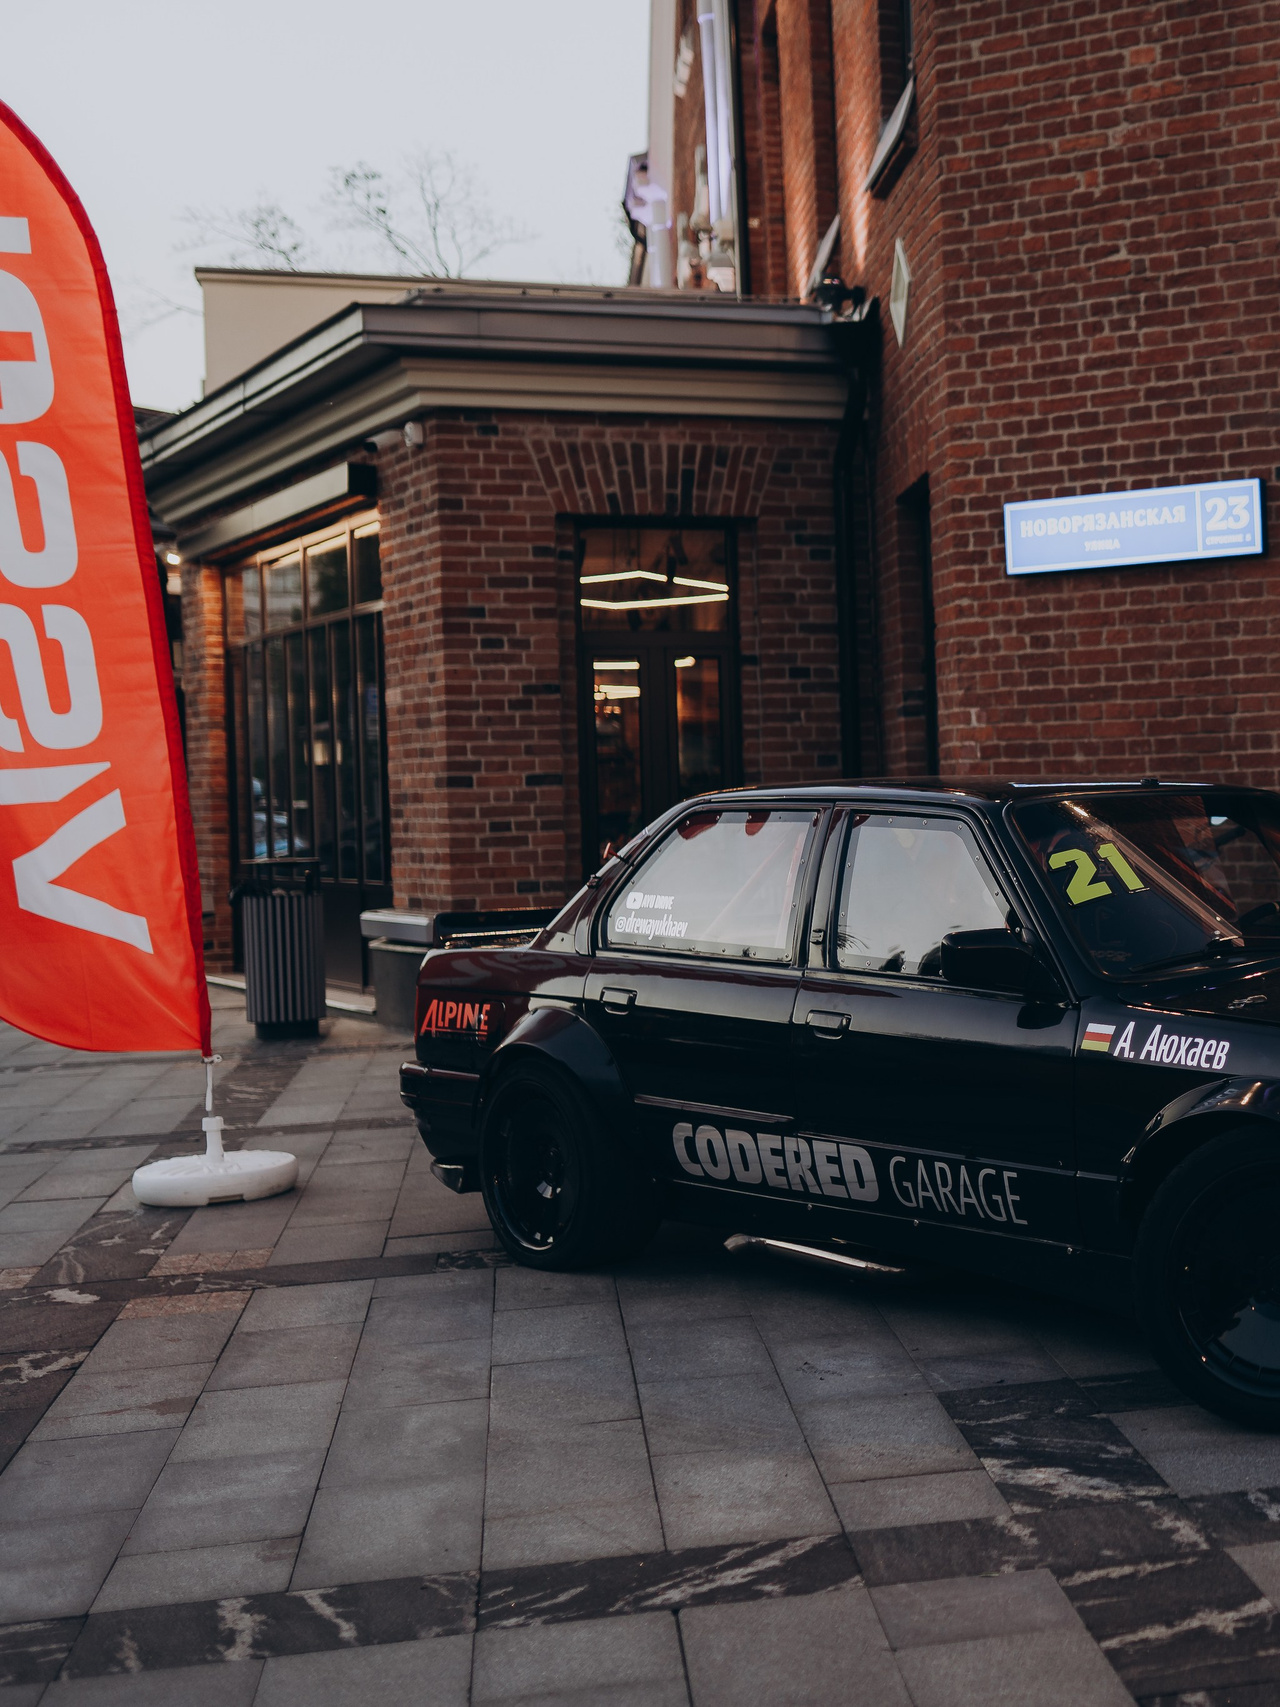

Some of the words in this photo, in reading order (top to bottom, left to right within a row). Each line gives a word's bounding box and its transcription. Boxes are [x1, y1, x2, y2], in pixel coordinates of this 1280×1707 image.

[1020, 505, 1186, 538] НОВОРЯЗАНСКАЯ
[1205, 495, 1250, 531] 23
[1048, 842, 1146, 905] 21
[420, 999, 491, 1038] ALPINE
[1113, 1021, 1136, 1059] А.
[1139, 1024, 1231, 1070] Аюхаев
[672, 1122, 880, 1203] CODERED
[889, 1155, 1029, 1225] GARAGE
